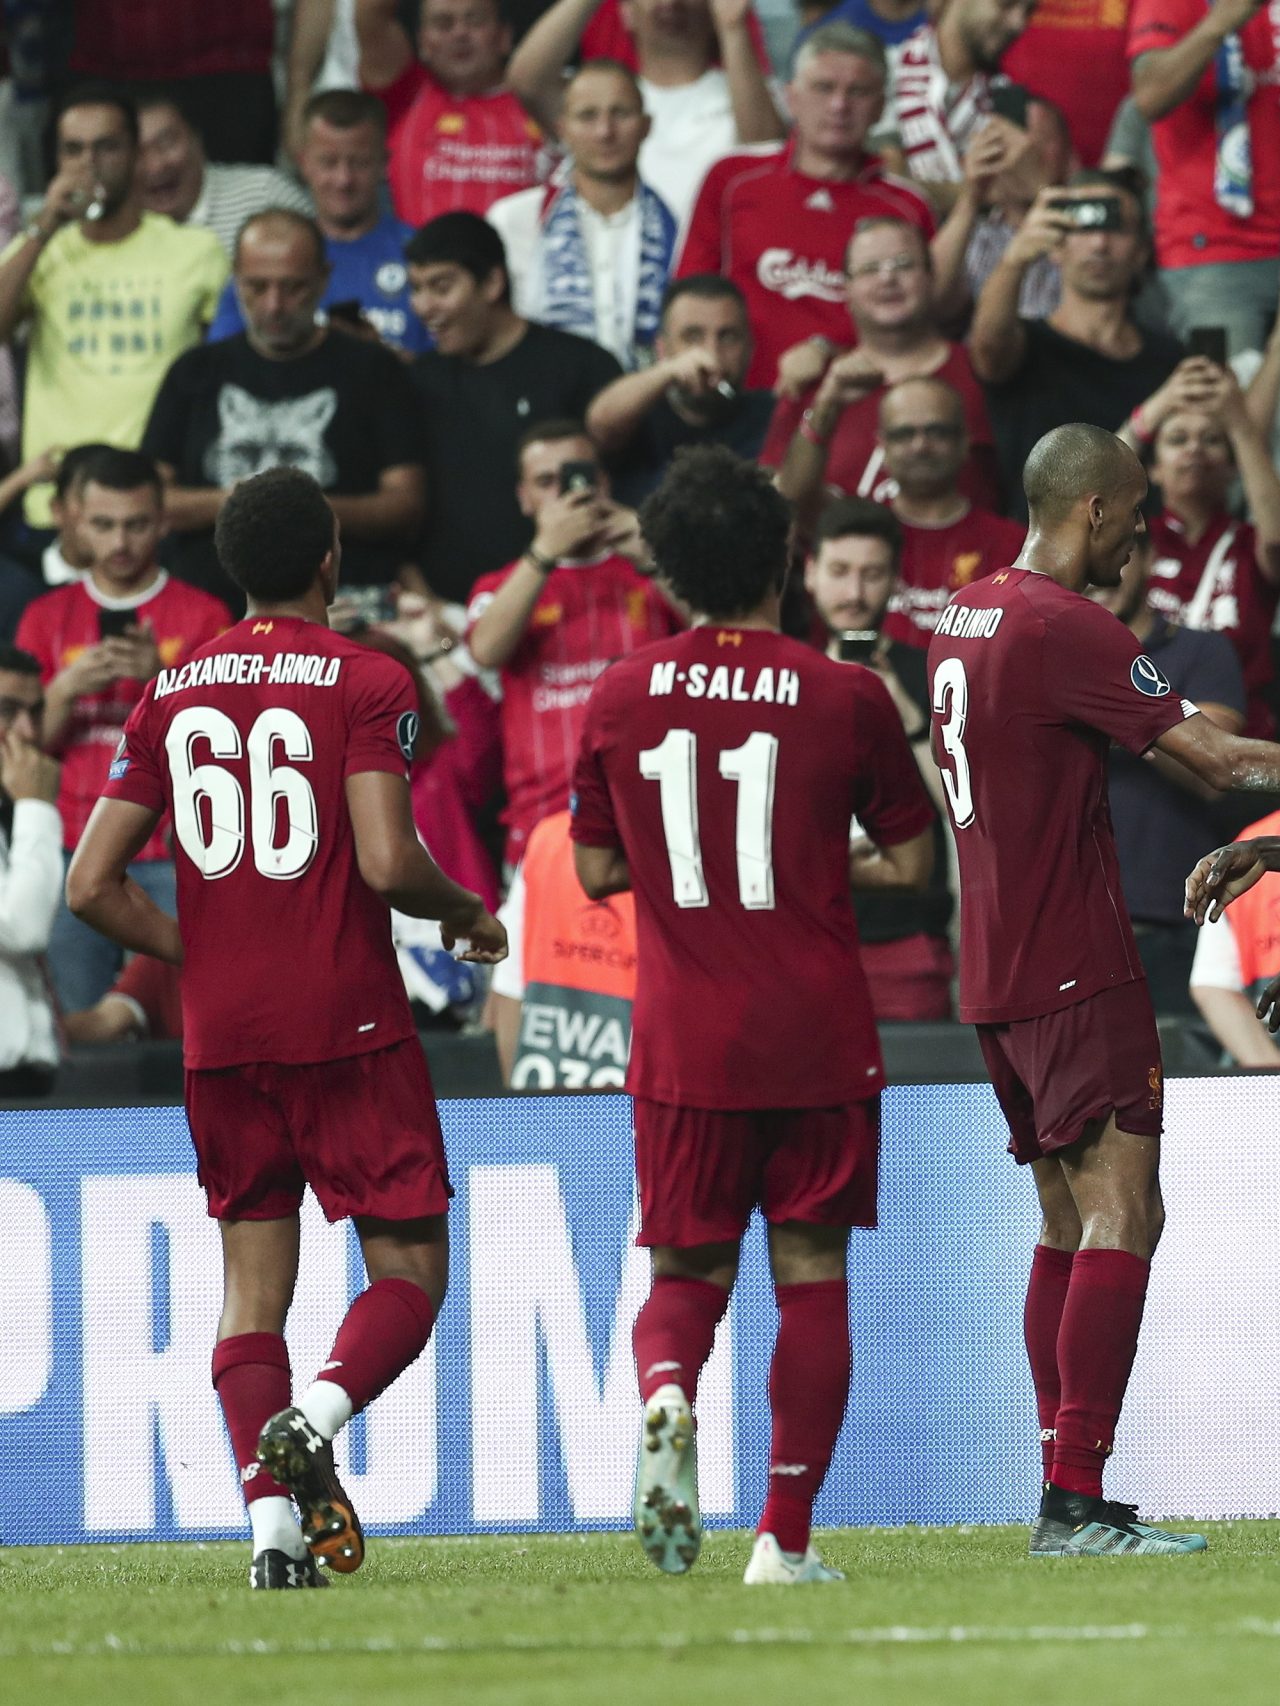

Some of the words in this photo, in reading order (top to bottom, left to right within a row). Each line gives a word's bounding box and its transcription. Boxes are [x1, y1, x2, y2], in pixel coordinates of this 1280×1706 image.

[153, 652, 342, 701] ALEXANDER-ARNOLD
[933, 604, 1004, 639] FABINHO
[164, 706, 319, 881] 66
[933, 657, 976, 830] 3
[638, 728, 779, 911] 11
[522, 1002, 628, 1066] EWA
